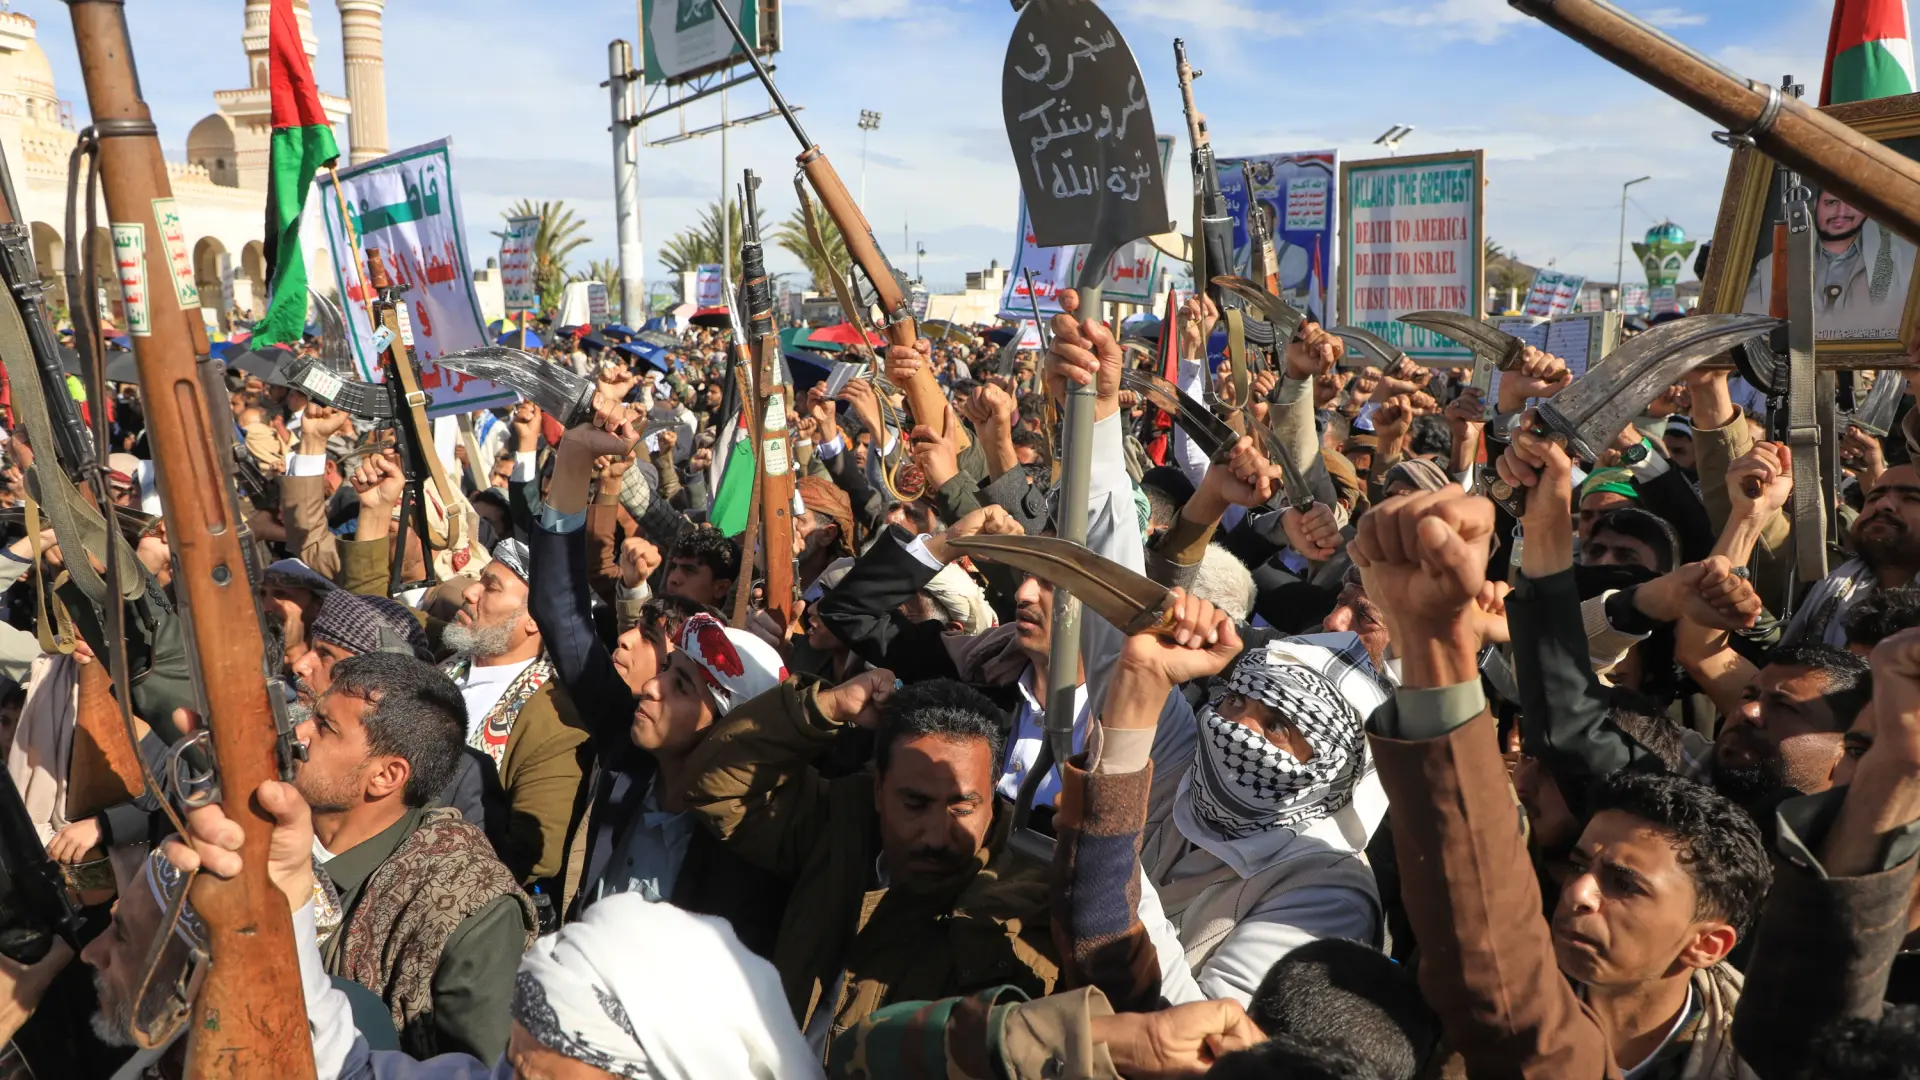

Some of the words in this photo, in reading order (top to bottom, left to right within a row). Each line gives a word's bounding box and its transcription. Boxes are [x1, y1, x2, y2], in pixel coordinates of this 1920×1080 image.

[1052, 147, 1100, 198] الله
[1355, 174, 1384, 208] ALLAH
[1386, 173, 1396, 206] IS
[1398, 171, 1418, 206] THE
[1420, 168, 1472, 204] GREATEST
[1355, 220, 1392, 244] DEATH
[1395, 219, 1411, 242] TO
[1413, 216, 1468, 242] AMERICA
[1355, 252, 1392, 276] DEATH
[1395, 251, 1411, 275] TO
[1413, 250, 1457, 275] ISRAEL
[1355, 287, 1385, 311] CURSE
[1387, 286, 1415, 311] UPON
[1416, 286, 1437, 310] THE
[1438, 285, 1467, 310] JEWS
[1409, 323, 1427, 348] TO
